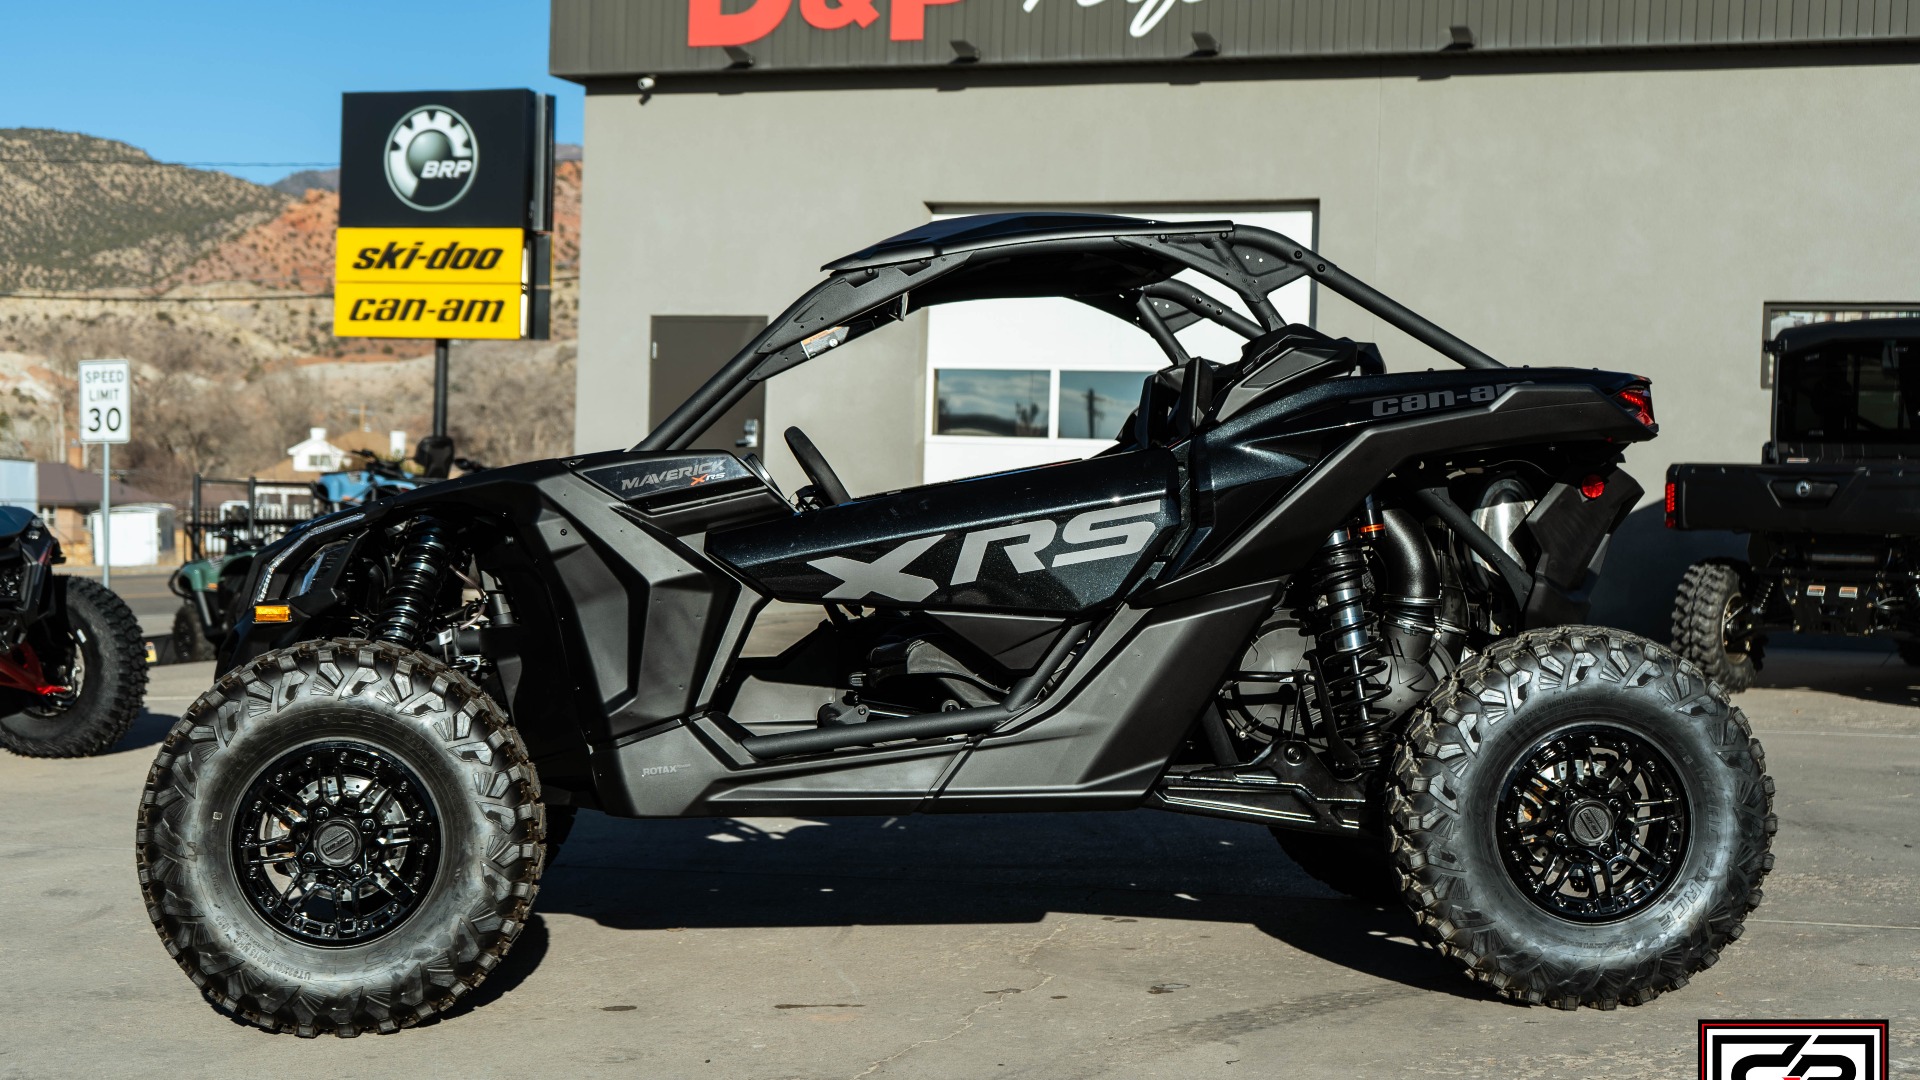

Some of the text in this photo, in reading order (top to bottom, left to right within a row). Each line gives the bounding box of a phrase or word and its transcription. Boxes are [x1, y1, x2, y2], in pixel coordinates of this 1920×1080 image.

[421, 160, 472, 179] BRP
[352, 241, 504, 270] ski-doo
[349, 298, 505, 322] can-am
[85, 370, 124, 383] SPEED
[89, 389, 120, 401] LIMIT
[88, 407, 121, 432] 30
[621, 459, 727, 490] MAVERICK
[690, 472, 726, 486] XRS
[806, 499, 1160, 603] XRS
[643, 765, 677, 775] ROTAX
[1659, 851, 1714, 931] FORCE
